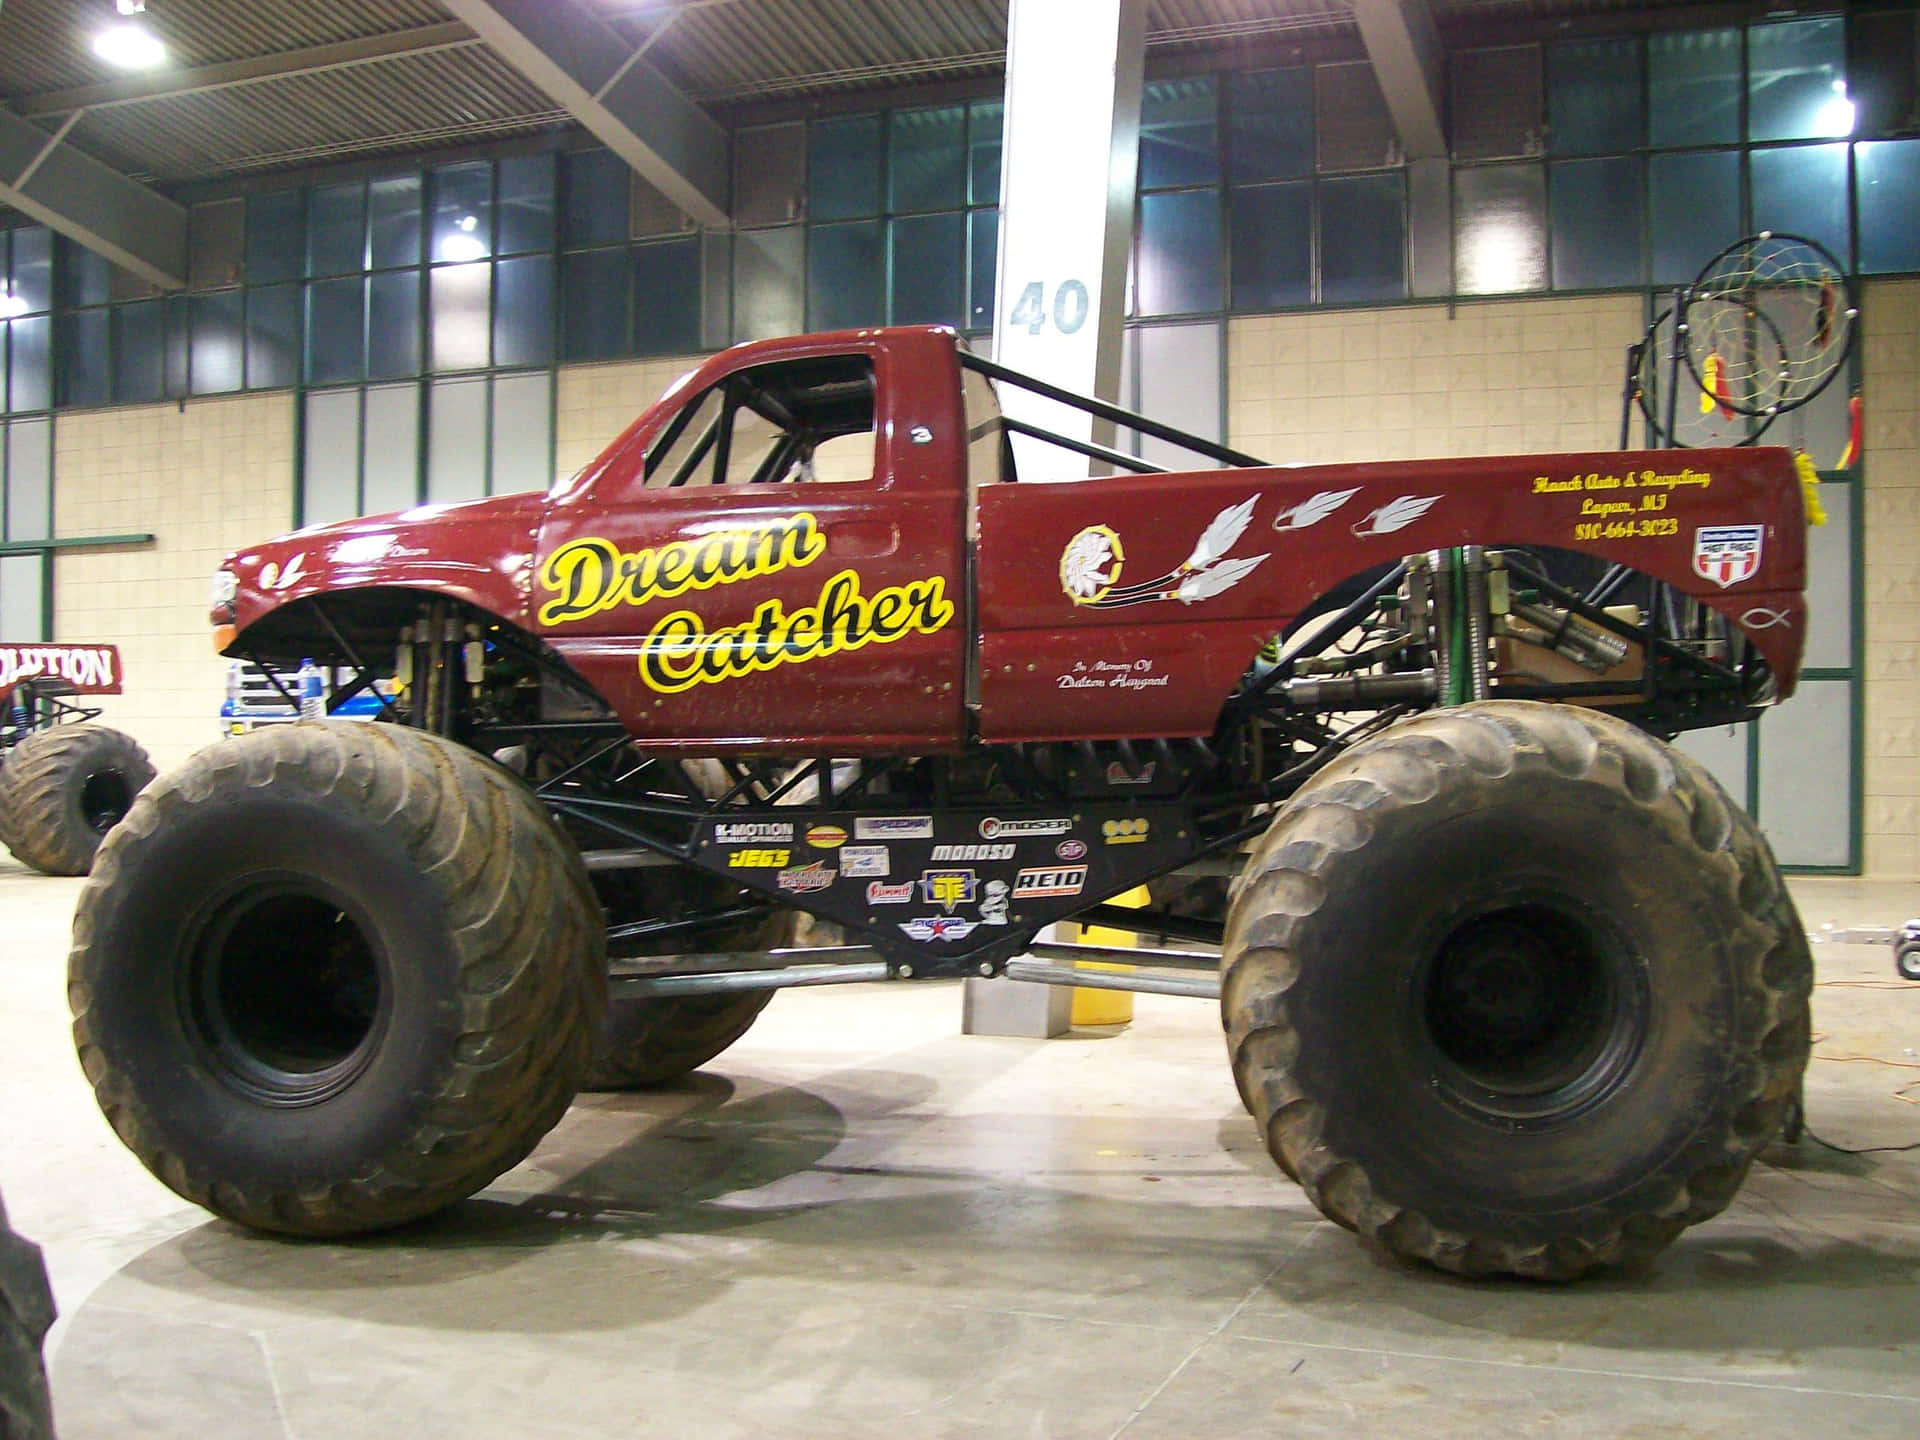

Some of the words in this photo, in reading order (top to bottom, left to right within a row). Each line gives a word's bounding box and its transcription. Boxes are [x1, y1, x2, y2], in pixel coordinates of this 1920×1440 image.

[1010, 279, 1089, 335] 40
[1585, 473, 1621, 490] Auto
[1623, 471, 1638, 488] &
[1639, 468, 1711, 491] Recycling
[538, 512, 827, 627] Dream
[638, 569, 955, 694] Catcher
[1072, 661, 1087, 673] In
[1088, 660, 1132, 673] Memory
[1134, 659, 1153, 673] Of
[715, 822, 794, 836] K-MOTION
[930, 844, 1017, 861] MOROSO
[1018, 871, 1083, 889] REID
